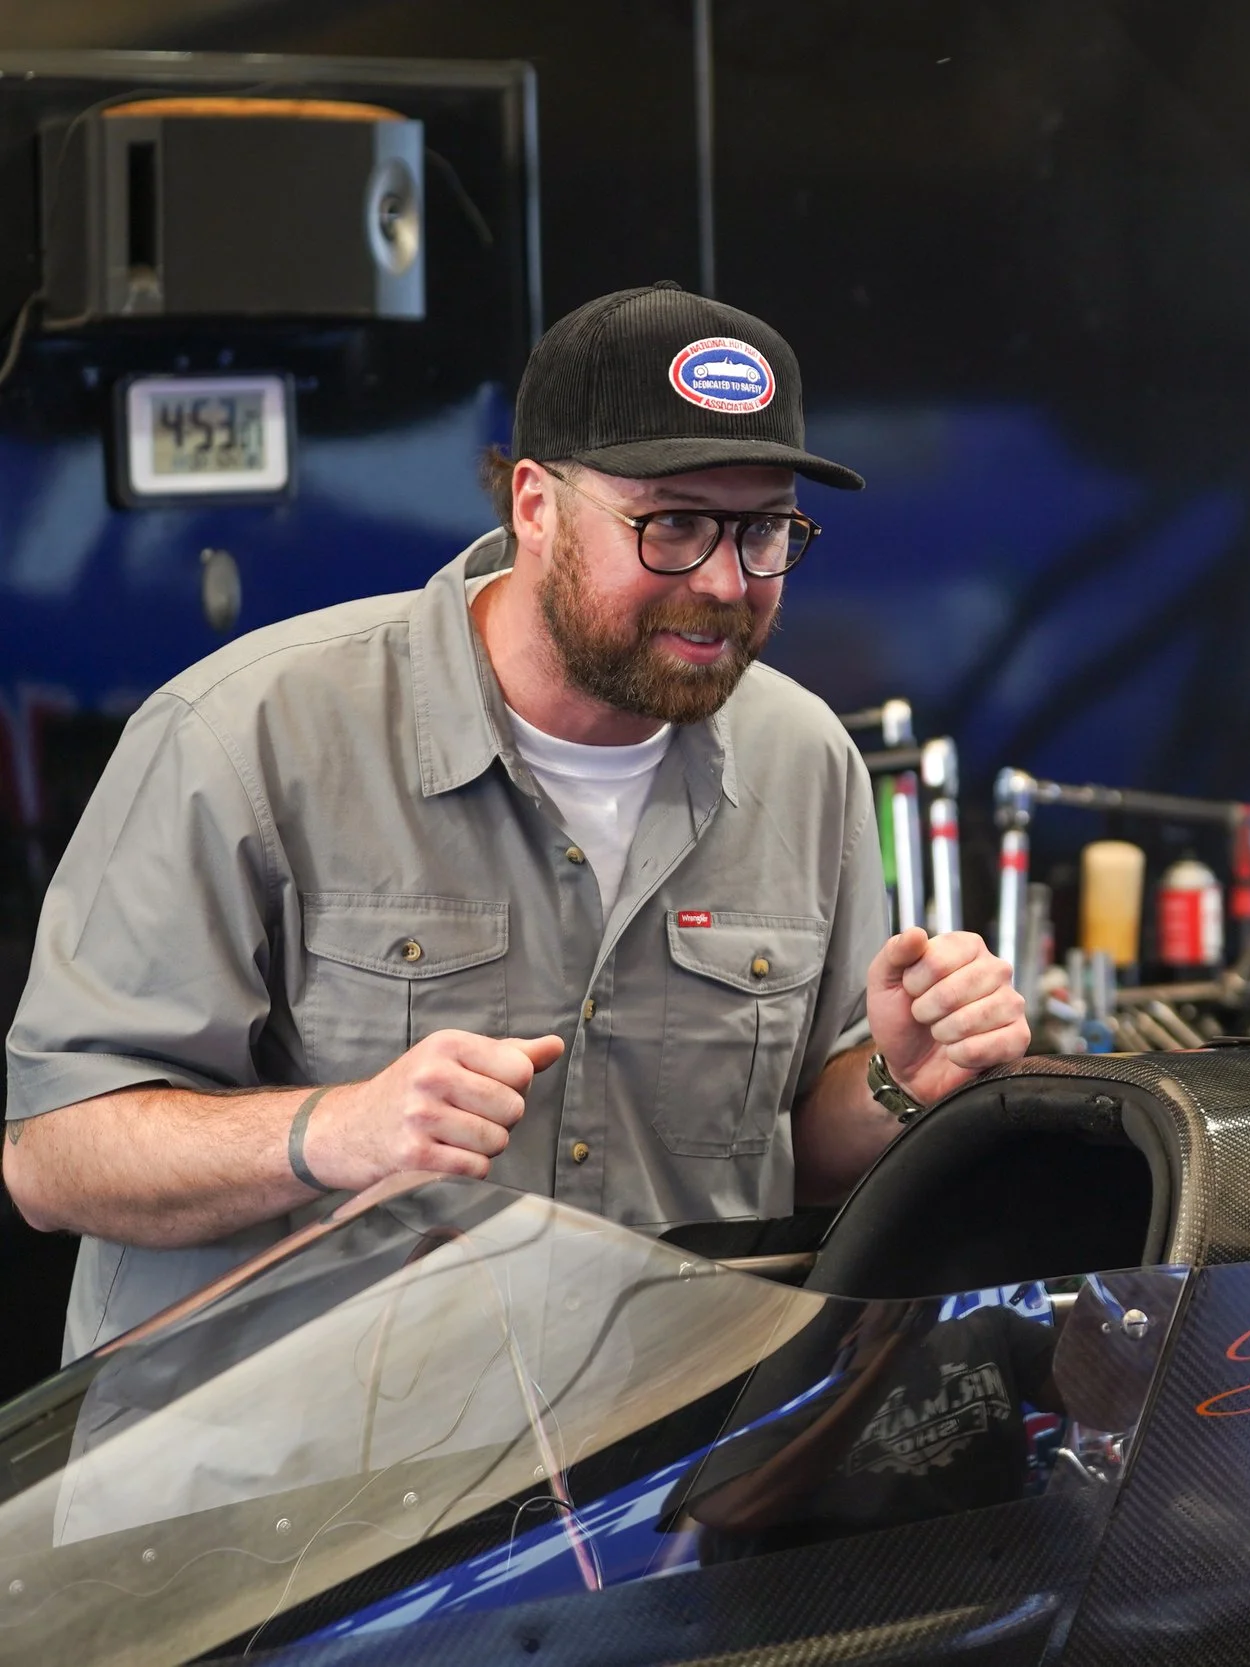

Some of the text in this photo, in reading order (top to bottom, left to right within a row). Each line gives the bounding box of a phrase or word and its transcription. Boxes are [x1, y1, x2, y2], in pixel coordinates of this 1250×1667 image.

[689, 340, 726, 354] NATIONAL
[693, 380, 762, 394] DEDICATED TO SAFETY
[704, 398, 754, 411] ASSOCIATION
[682, 914, 708, 924] Wrangler
